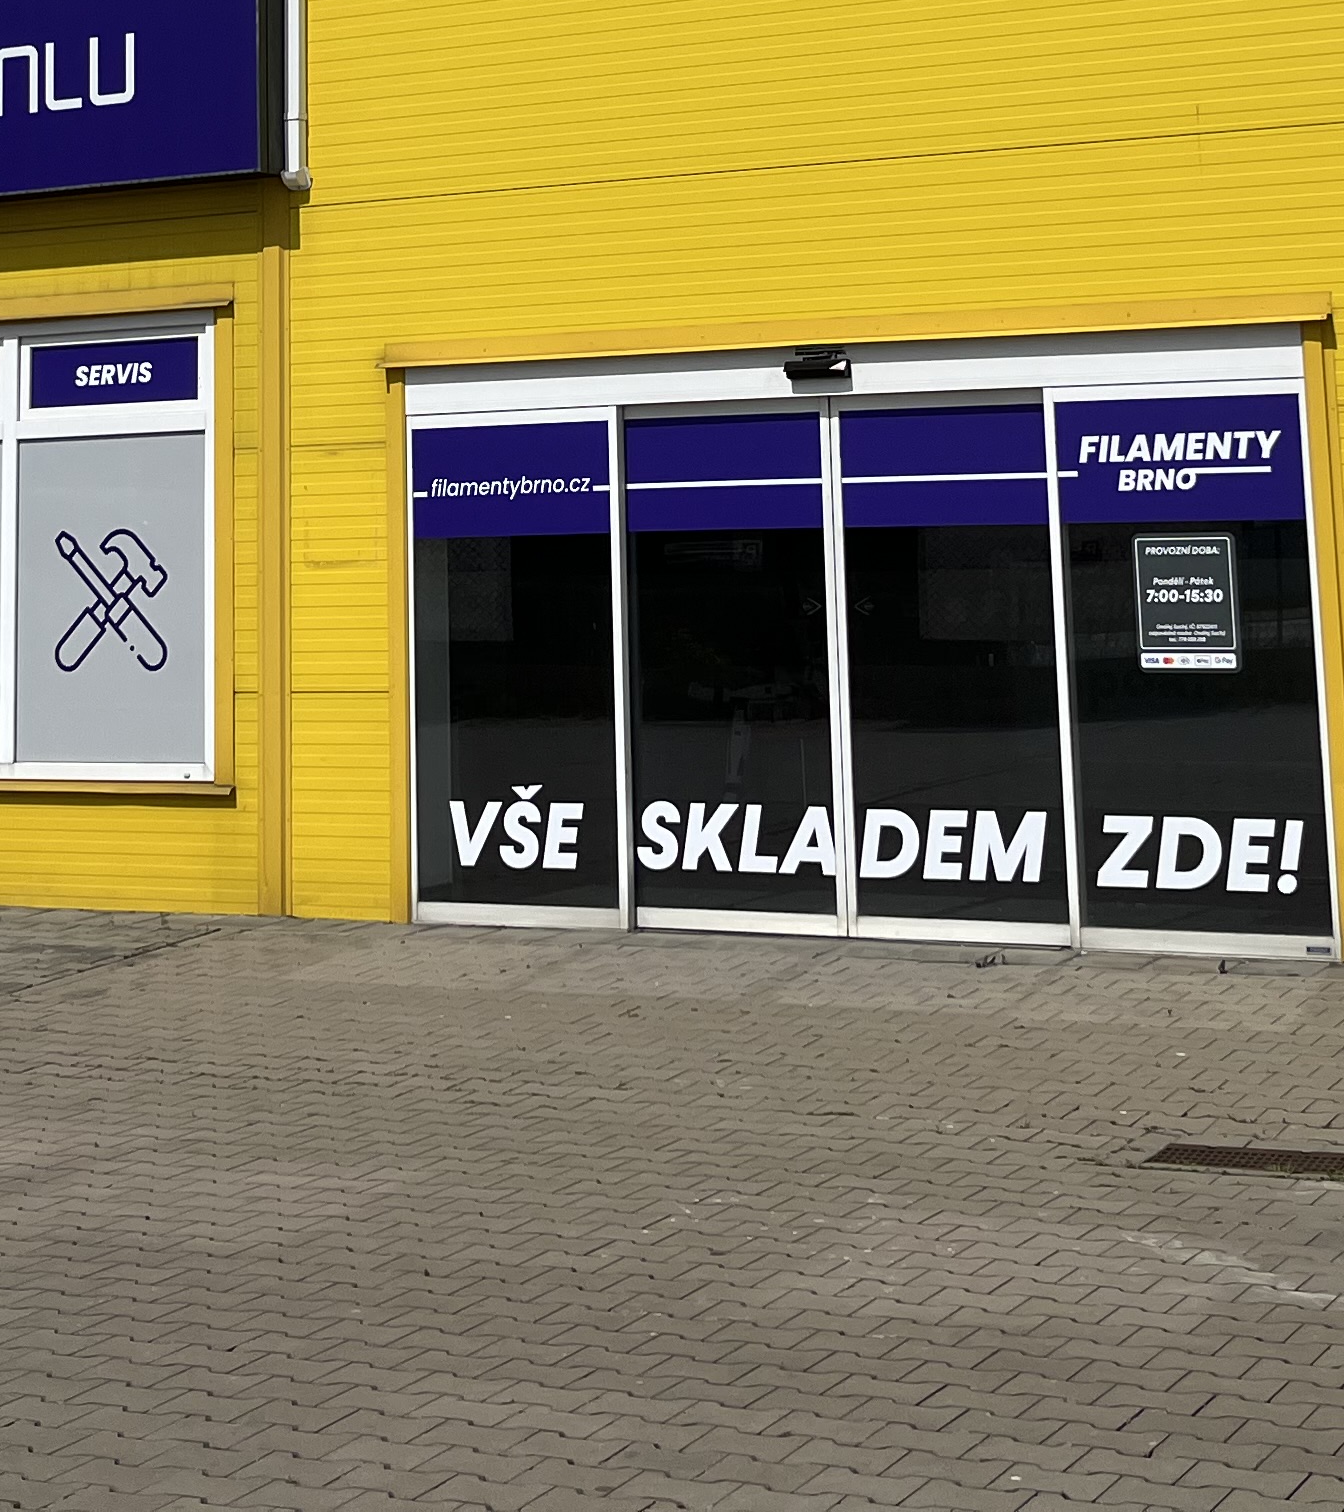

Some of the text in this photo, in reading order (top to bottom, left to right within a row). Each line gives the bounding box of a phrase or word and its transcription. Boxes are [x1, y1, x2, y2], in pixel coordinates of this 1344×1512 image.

[75, 362, 152, 386] SERVIS
[1078, 430, 1281, 465] FILAMENTY
[432, 476, 590, 500] filamentybrno.cz
[1118, 467, 1198, 492] BRNO
[1145, 545, 1191, 555] PROVOZNÍ
[1189, 577, 1213, 585] Pátek
[1147, 589, 1223, 602] 7:00-15:30
[450, 785, 584, 869] VŠE
[1097, 815, 1303, 894] ZDE!
